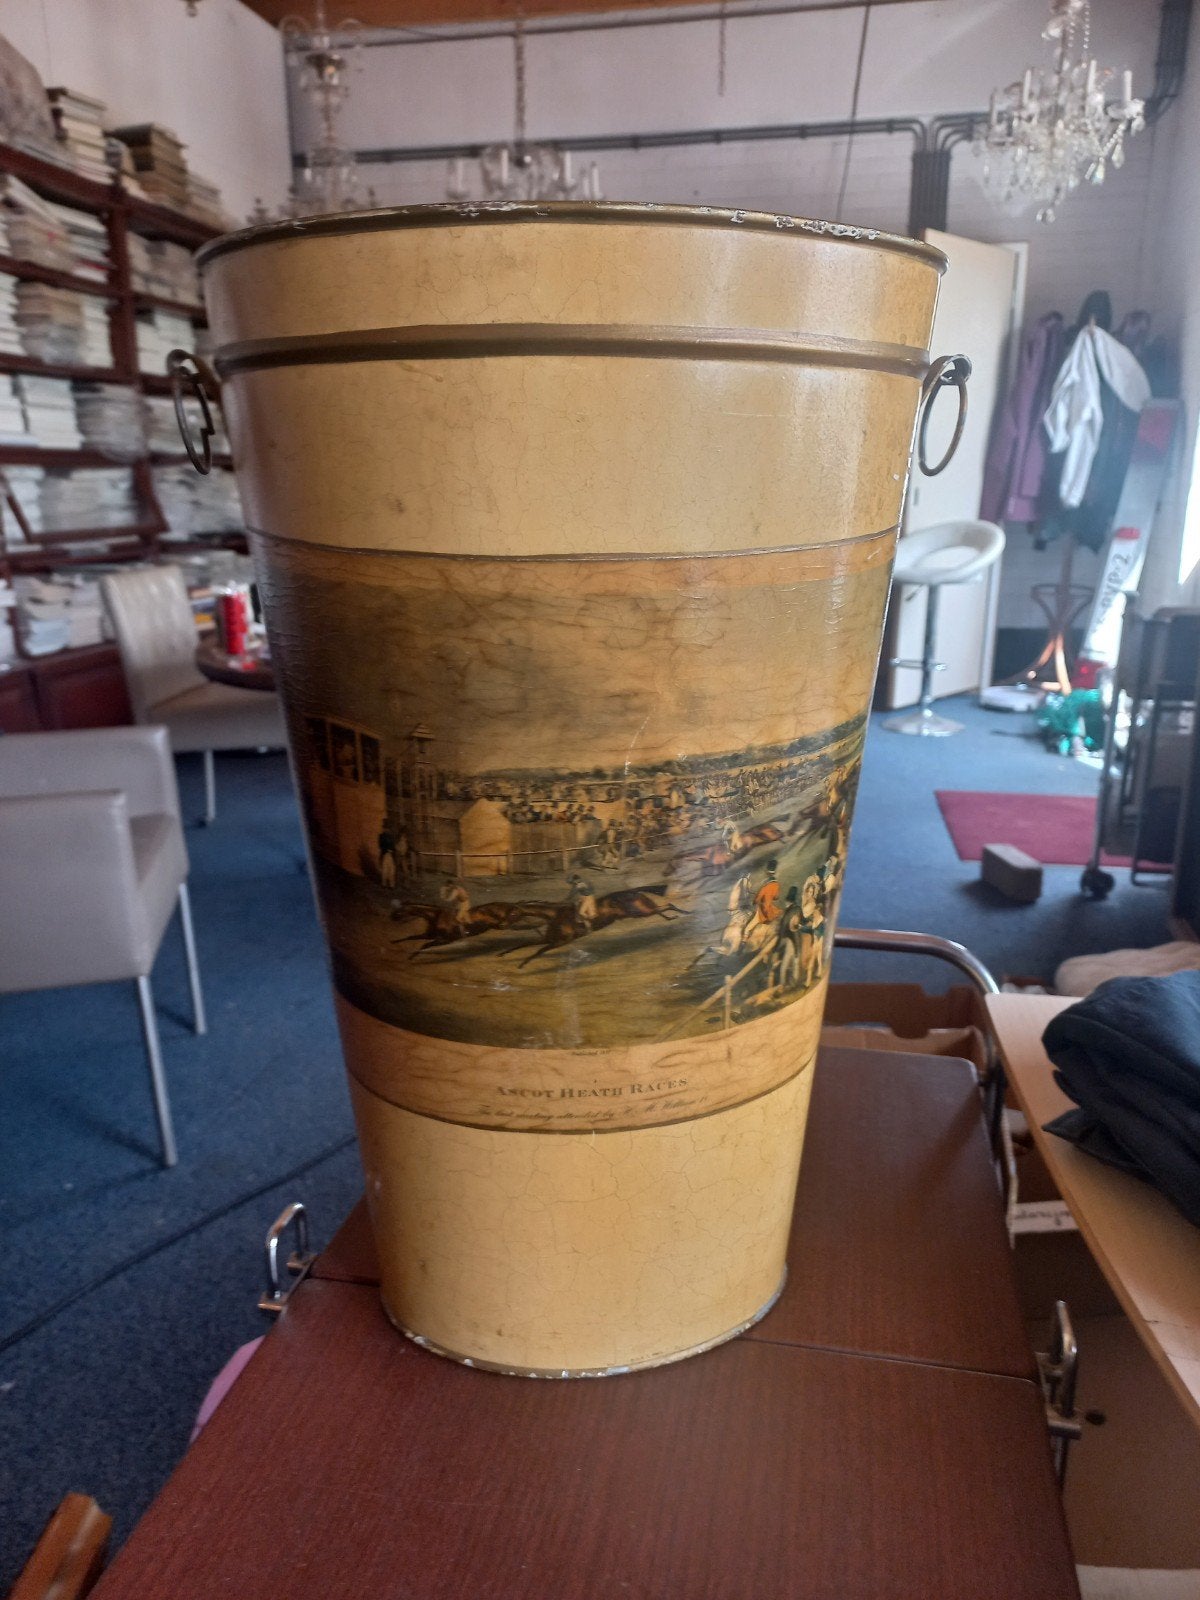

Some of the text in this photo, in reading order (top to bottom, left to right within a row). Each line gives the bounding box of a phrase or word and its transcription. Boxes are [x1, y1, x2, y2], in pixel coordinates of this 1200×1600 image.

[497, 1078, 688, 1099] ASCOT HEATH RACES
